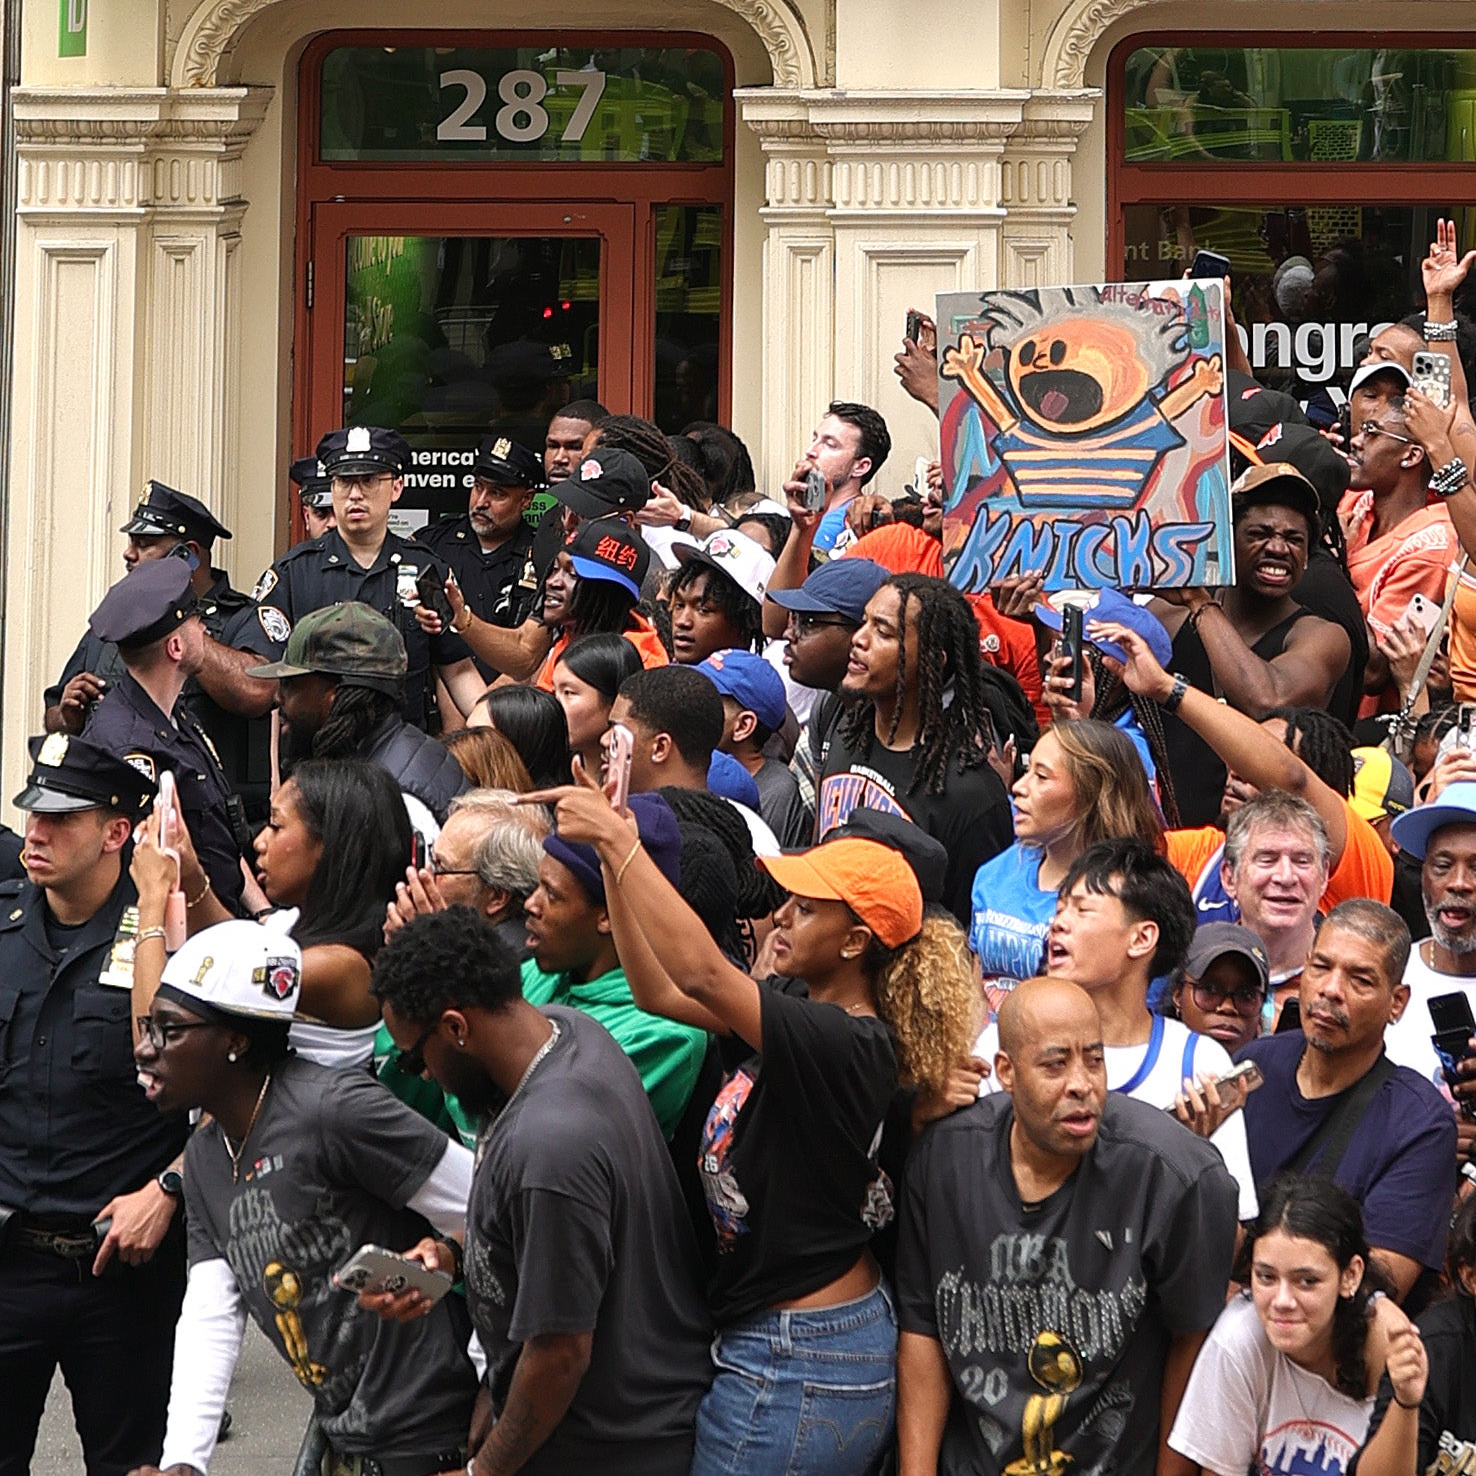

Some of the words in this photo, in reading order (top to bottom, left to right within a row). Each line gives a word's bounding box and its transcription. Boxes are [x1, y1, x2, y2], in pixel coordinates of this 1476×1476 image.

[435, 70, 607, 142] 287
[595, 534, 639, 572] 纽约
[950, 503, 1216, 594] KNICKS
[849, 763, 896, 797] BASKETBALL
[959, 1364, 1009, 1406] 20
